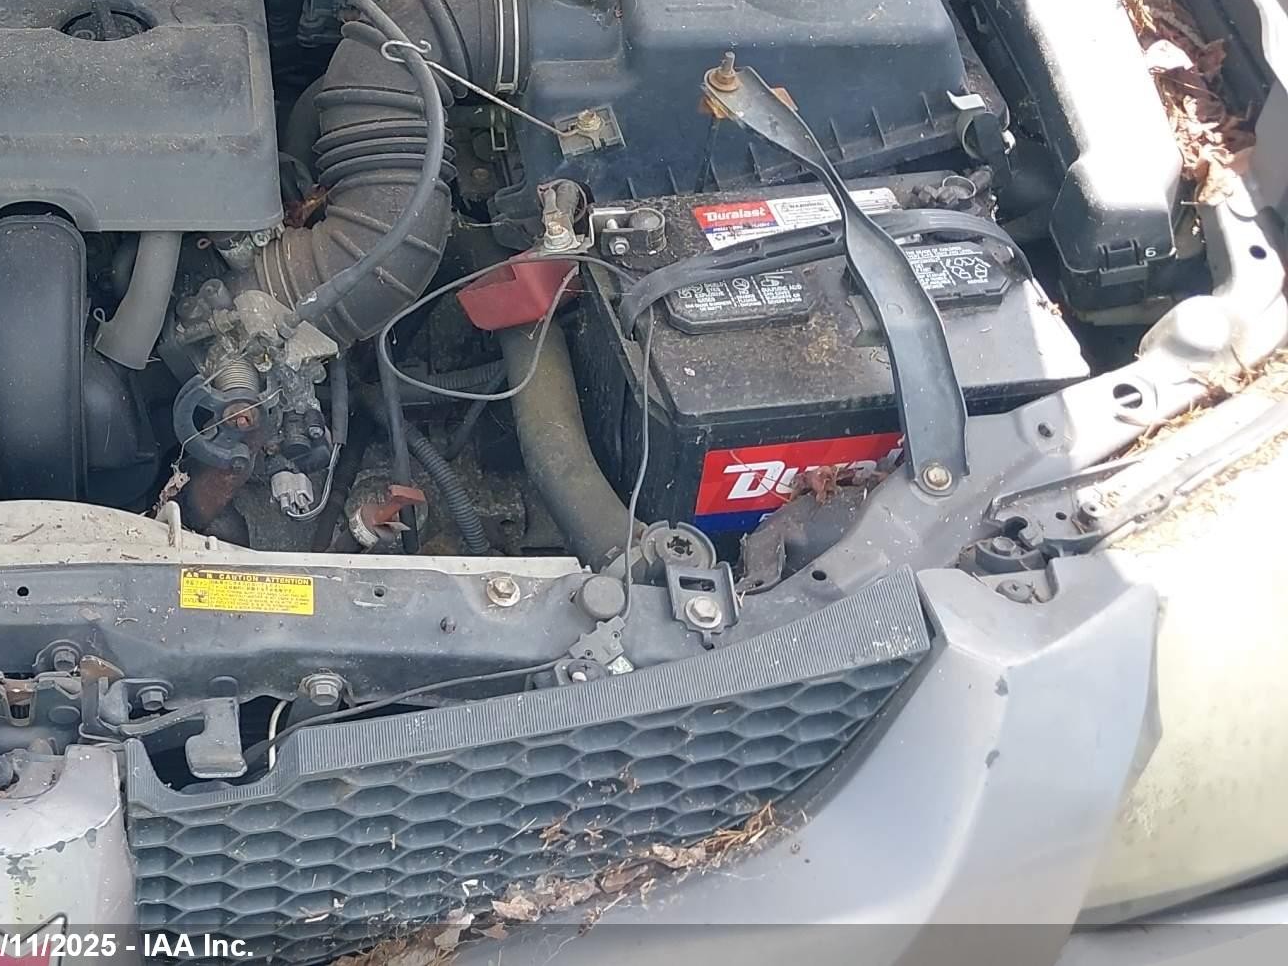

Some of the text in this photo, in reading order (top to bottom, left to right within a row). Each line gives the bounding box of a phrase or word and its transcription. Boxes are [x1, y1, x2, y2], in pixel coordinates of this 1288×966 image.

[703, 206, 766, 222] Duralast
[1145, 247, 1157, 258] 6
[219, 574, 259, 582] CAUTION
[265, 576, 309, 585] ATTENTION
